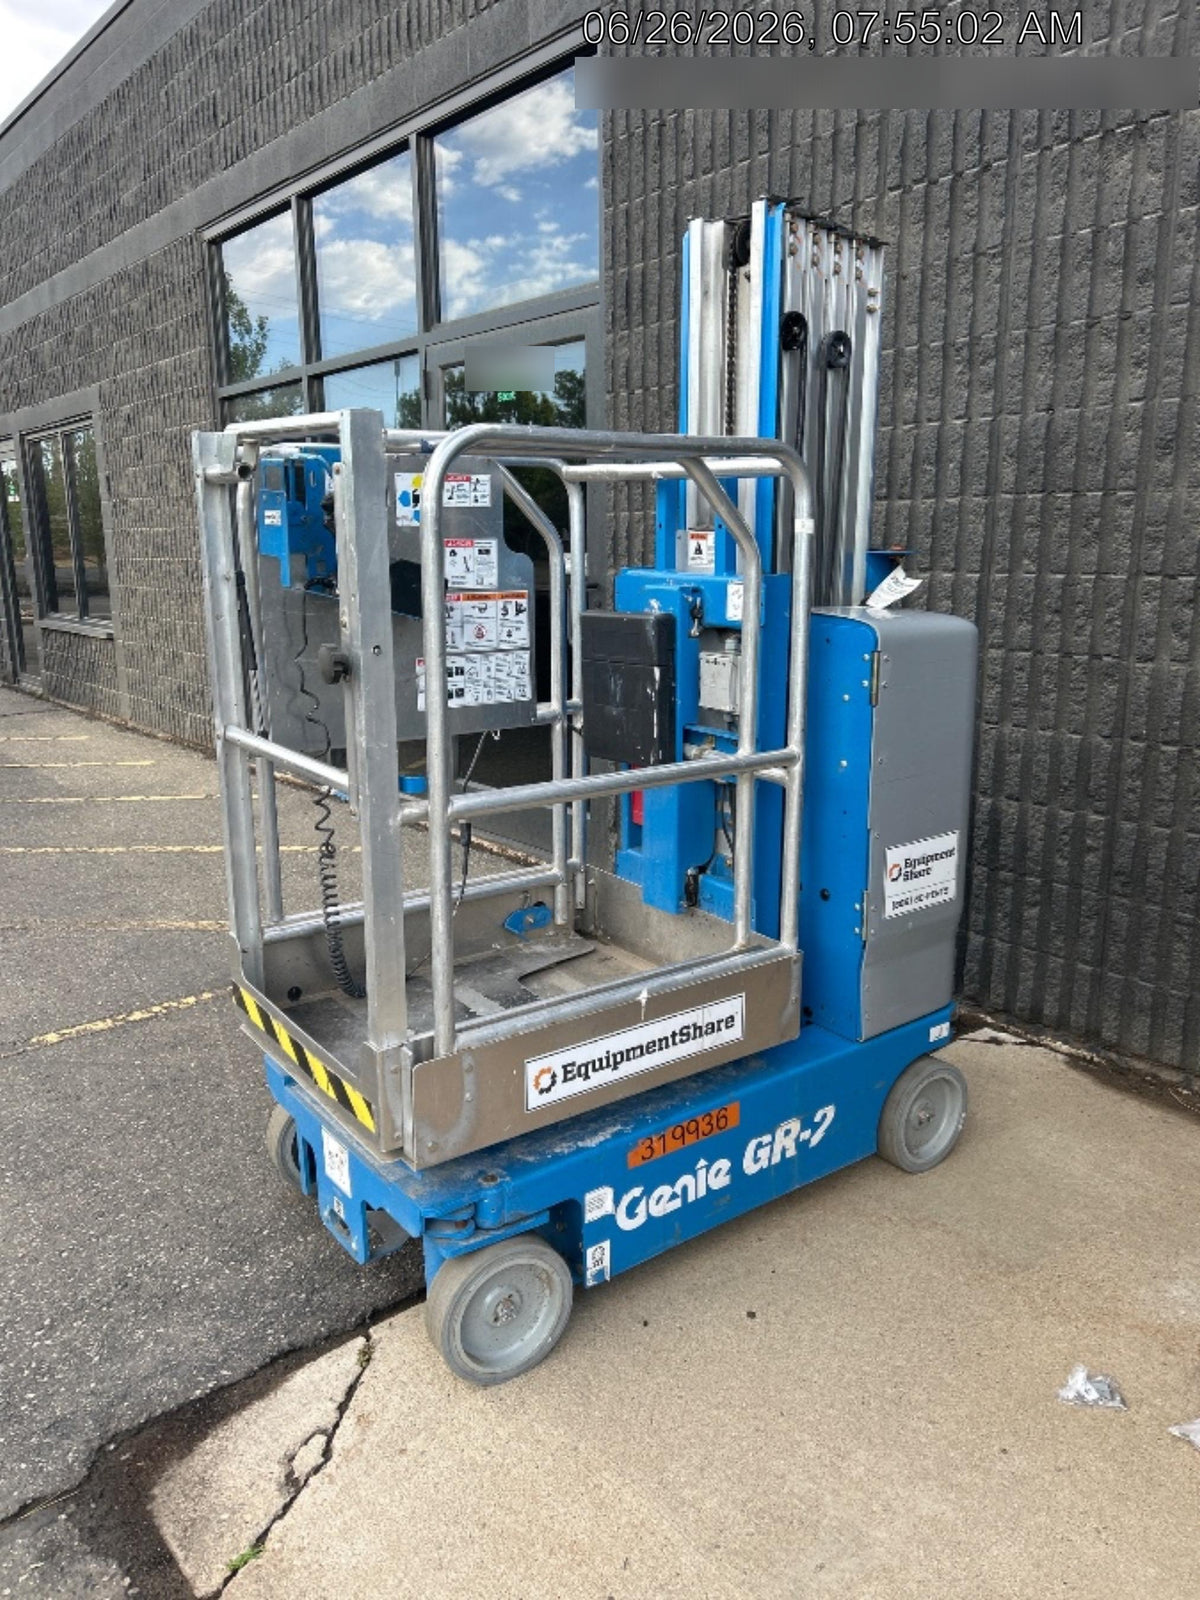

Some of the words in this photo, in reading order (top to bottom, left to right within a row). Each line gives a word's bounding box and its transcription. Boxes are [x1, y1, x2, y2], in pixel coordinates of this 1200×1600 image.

[561, 1014, 736, 1084] EquipmentShare
[640, 1106, 729, 1161] 319936
[615, 1158, 732, 1231] Genie
